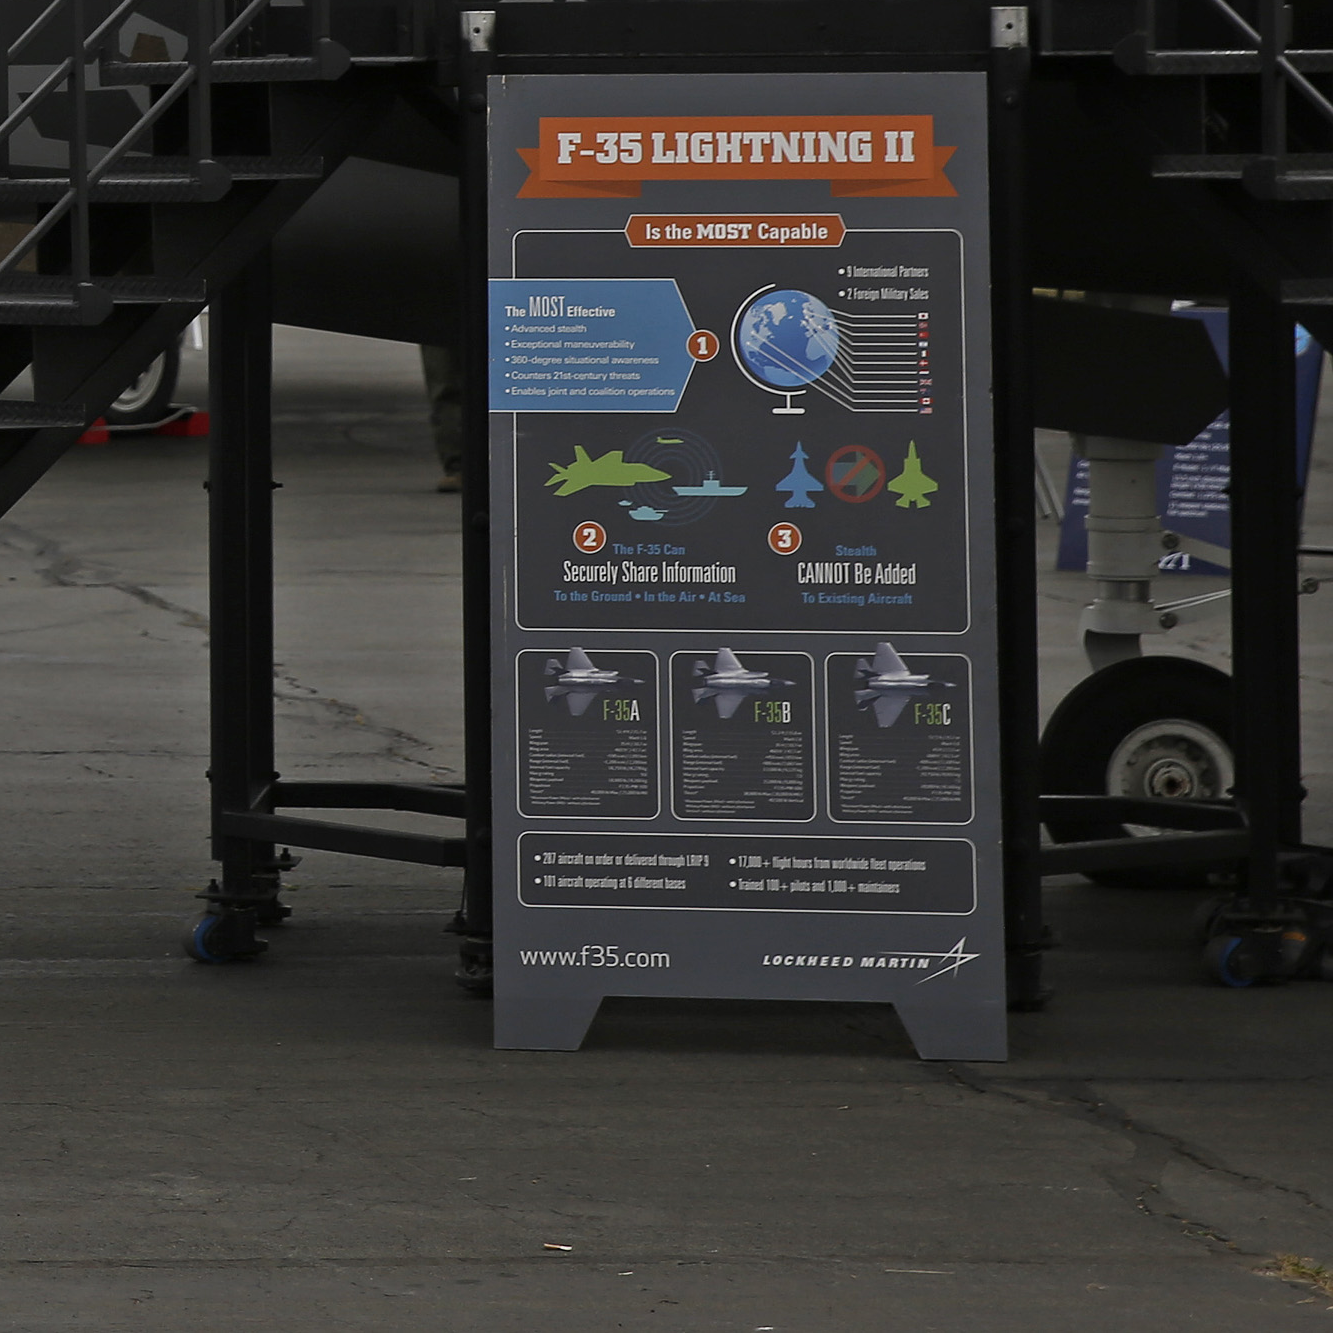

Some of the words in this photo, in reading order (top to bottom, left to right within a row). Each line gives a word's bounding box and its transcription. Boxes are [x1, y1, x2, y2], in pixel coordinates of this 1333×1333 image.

[557, 132, 643, 164] F-35
[651, 131, 872, 164] LIGHTNING
[884, 130, 915, 162] II
[645, 223, 661, 240] Is
[664, 223, 692, 240] the
[696, 224, 752, 239] MOST
[757, 223, 828, 244] Capable
[853, 265, 898, 277] International
[899, 265, 929, 277] Partners
[853, 288, 880, 301] Foreign
[881, 288, 908, 301] Military
[909, 288, 929, 300] Sales
[505, 305, 526, 317] The
[528, 296, 565, 317] MOST
[567, 305, 616, 317] Effective
[511, 325, 555, 334] Advanced
[557, 324, 587, 334] stealth
[511, 340, 562, 350] Exceptional
[564, 340, 635, 350] maneuverability
[697, 336, 708, 355] 1
[511, 356, 562, 366] 360-degree
[564, 356, 609, 365] situational
[611, 357, 659, 365] awareness
[511, 371, 551, 380] Counters
[553, 372, 608, 382] 21st-century
[609, 372, 641, 381] threats
[511, 387, 546, 396] Enables
[547, 387, 567, 397] joint
[569, 387, 586, 396] and
[588, 387, 626, 396] coalition
[628, 388, 675, 398] operations
[583, 528, 597, 546] 2
[777, 529, 792, 548] 3
[612, 543, 633, 555] The
[637, 544, 661, 555] F-35
[663, 544, 686, 555] Can
[835, 545, 877, 557] Stealth
[563, 561, 619, 585] Securely
[622, 561, 659, 583] Share
[662, 562, 736, 583] Information
[797, 562, 851, 584] CANNOT
[854, 563, 872, 584] Be
[874, 563, 916, 585] Added
[554, 590, 568, 602] To
[570, 591, 588, 602] the
[591, 591, 632, 602] Ground
[644, 592, 655, 602] In
[657, 592, 676, 602] the
[678, 592, 697, 602] Air
[708, 592, 721, 603] At
[723, 592, 746, 603] Sea
[801, 592, 816, 604] To
[818, 592, 866, 606] Existing
[867, 592, 913, 604] Aircraft
[603, 699, 640, 721] F-35A
[754, 701, 791, 723] F-35B
[914, 703, 951, 725] F-35C
[557, 852, 584, 865] aircraft
[595, 853, 614, 865] order
[624, 853, 657, 866] delivered
[658, 854, 685, 868] through
[772, 856, 791, 869] flight
[792, 857, 812, 869] hours
[831, 858, 869, 870] worldwide
[888, 859, 926, 871] operations
[557, 875, 583, 888] aircraft
[584, 876, 618, 890] operating
[633, 877, 664, 889] different
[811, 880, 826, 892] and
[520, 945, 670, 967] www.f35.com
[762, 954, 854, 968] LOCKHEED
[859, 956, 930, 969] MARTIN
